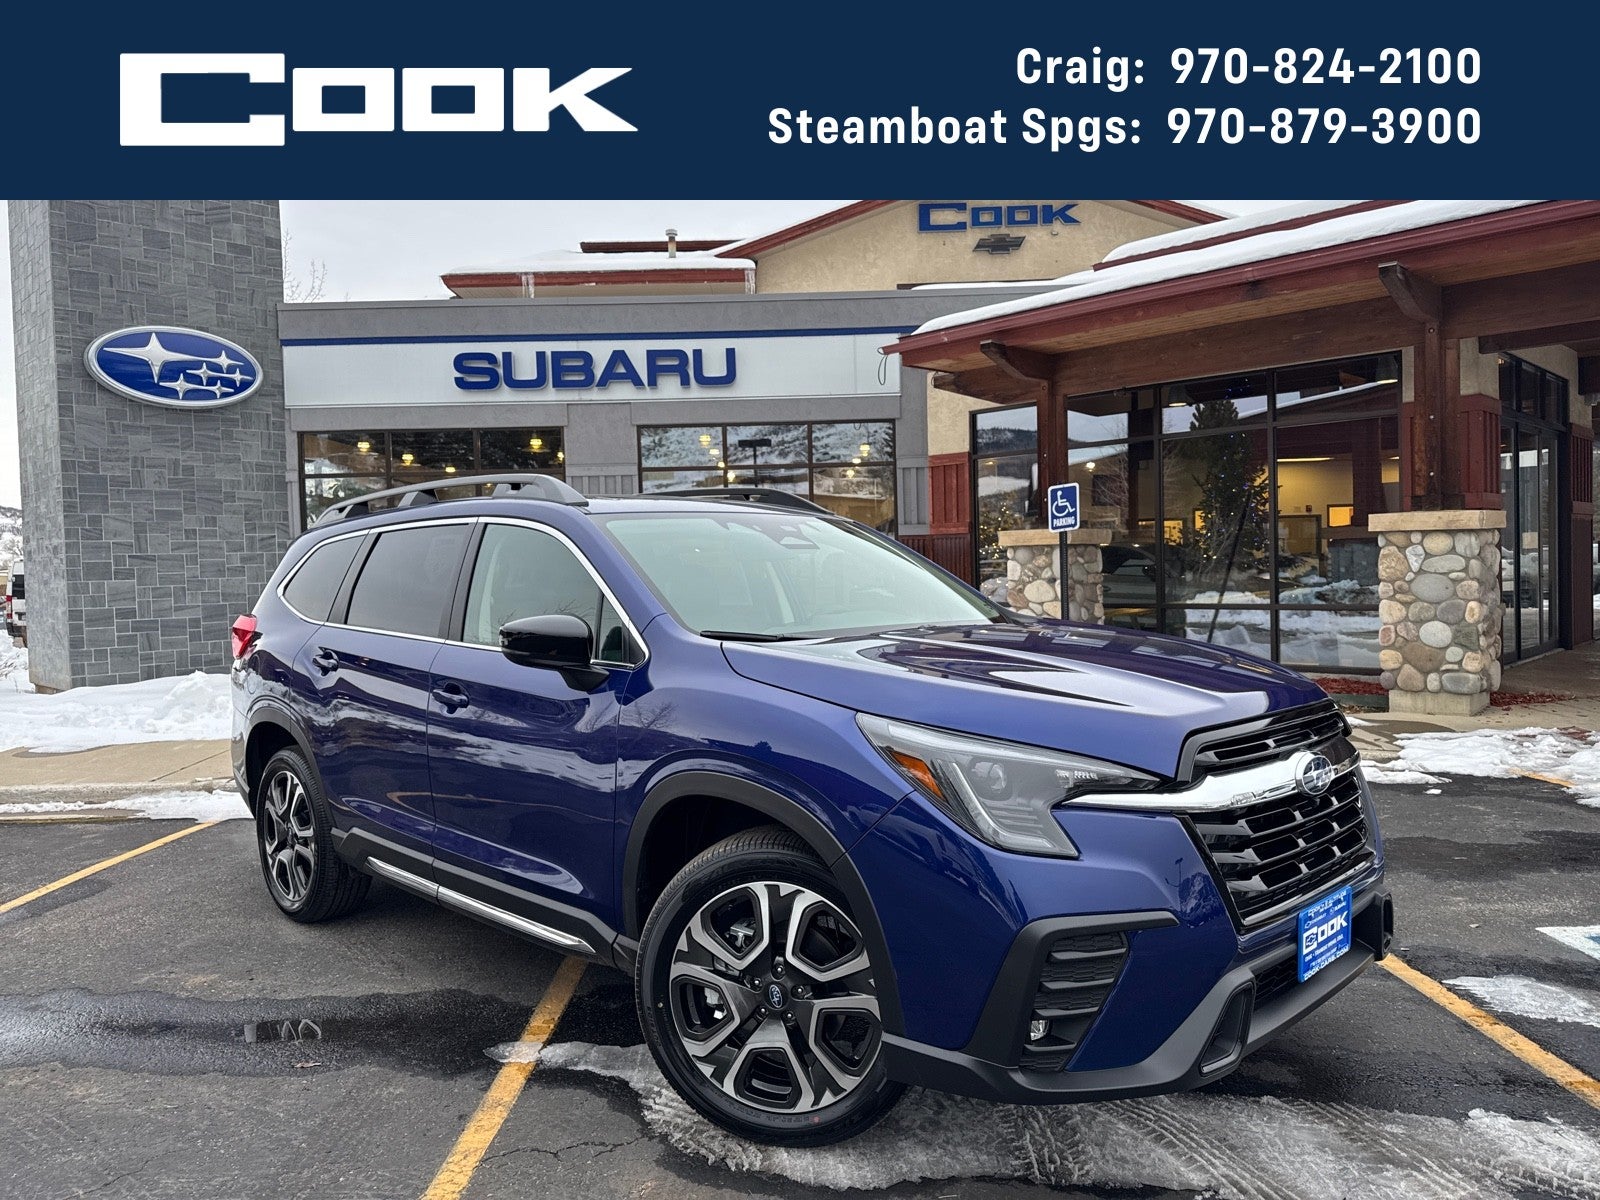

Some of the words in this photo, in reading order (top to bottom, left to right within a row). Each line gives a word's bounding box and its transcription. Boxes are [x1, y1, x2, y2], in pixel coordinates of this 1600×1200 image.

[918, 202, 1081, 232] COOK
[453, 347, 737, 391] SUBARU
[1053, 516, 1075, 527] PARKING
[1303, 911, 1348, 955] COOK
